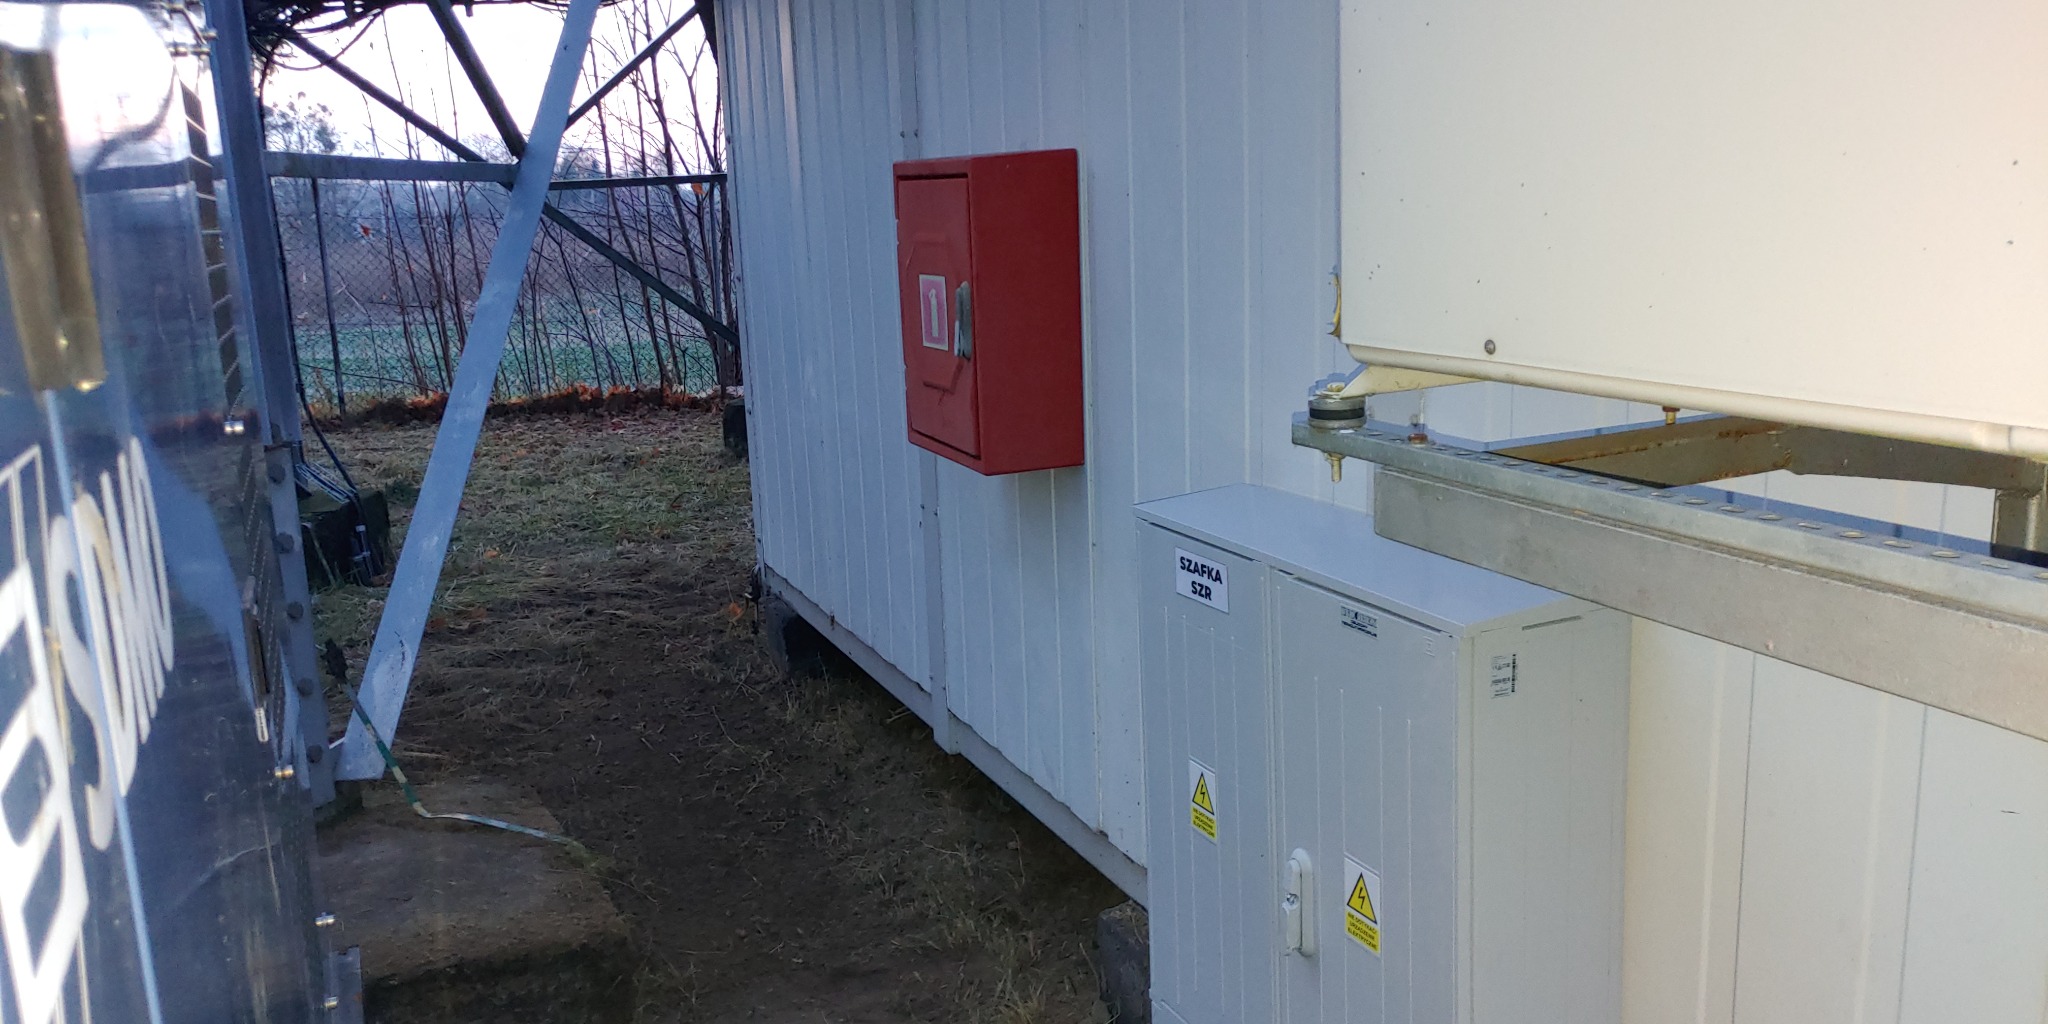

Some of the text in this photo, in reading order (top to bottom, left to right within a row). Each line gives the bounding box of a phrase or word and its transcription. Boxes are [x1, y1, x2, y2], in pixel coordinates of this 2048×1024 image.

[1179, 556, 1223, 585] SZAFKA
[1191, 580, 1212, 601] SZR
[50, 436, 174, 851] SDMO
